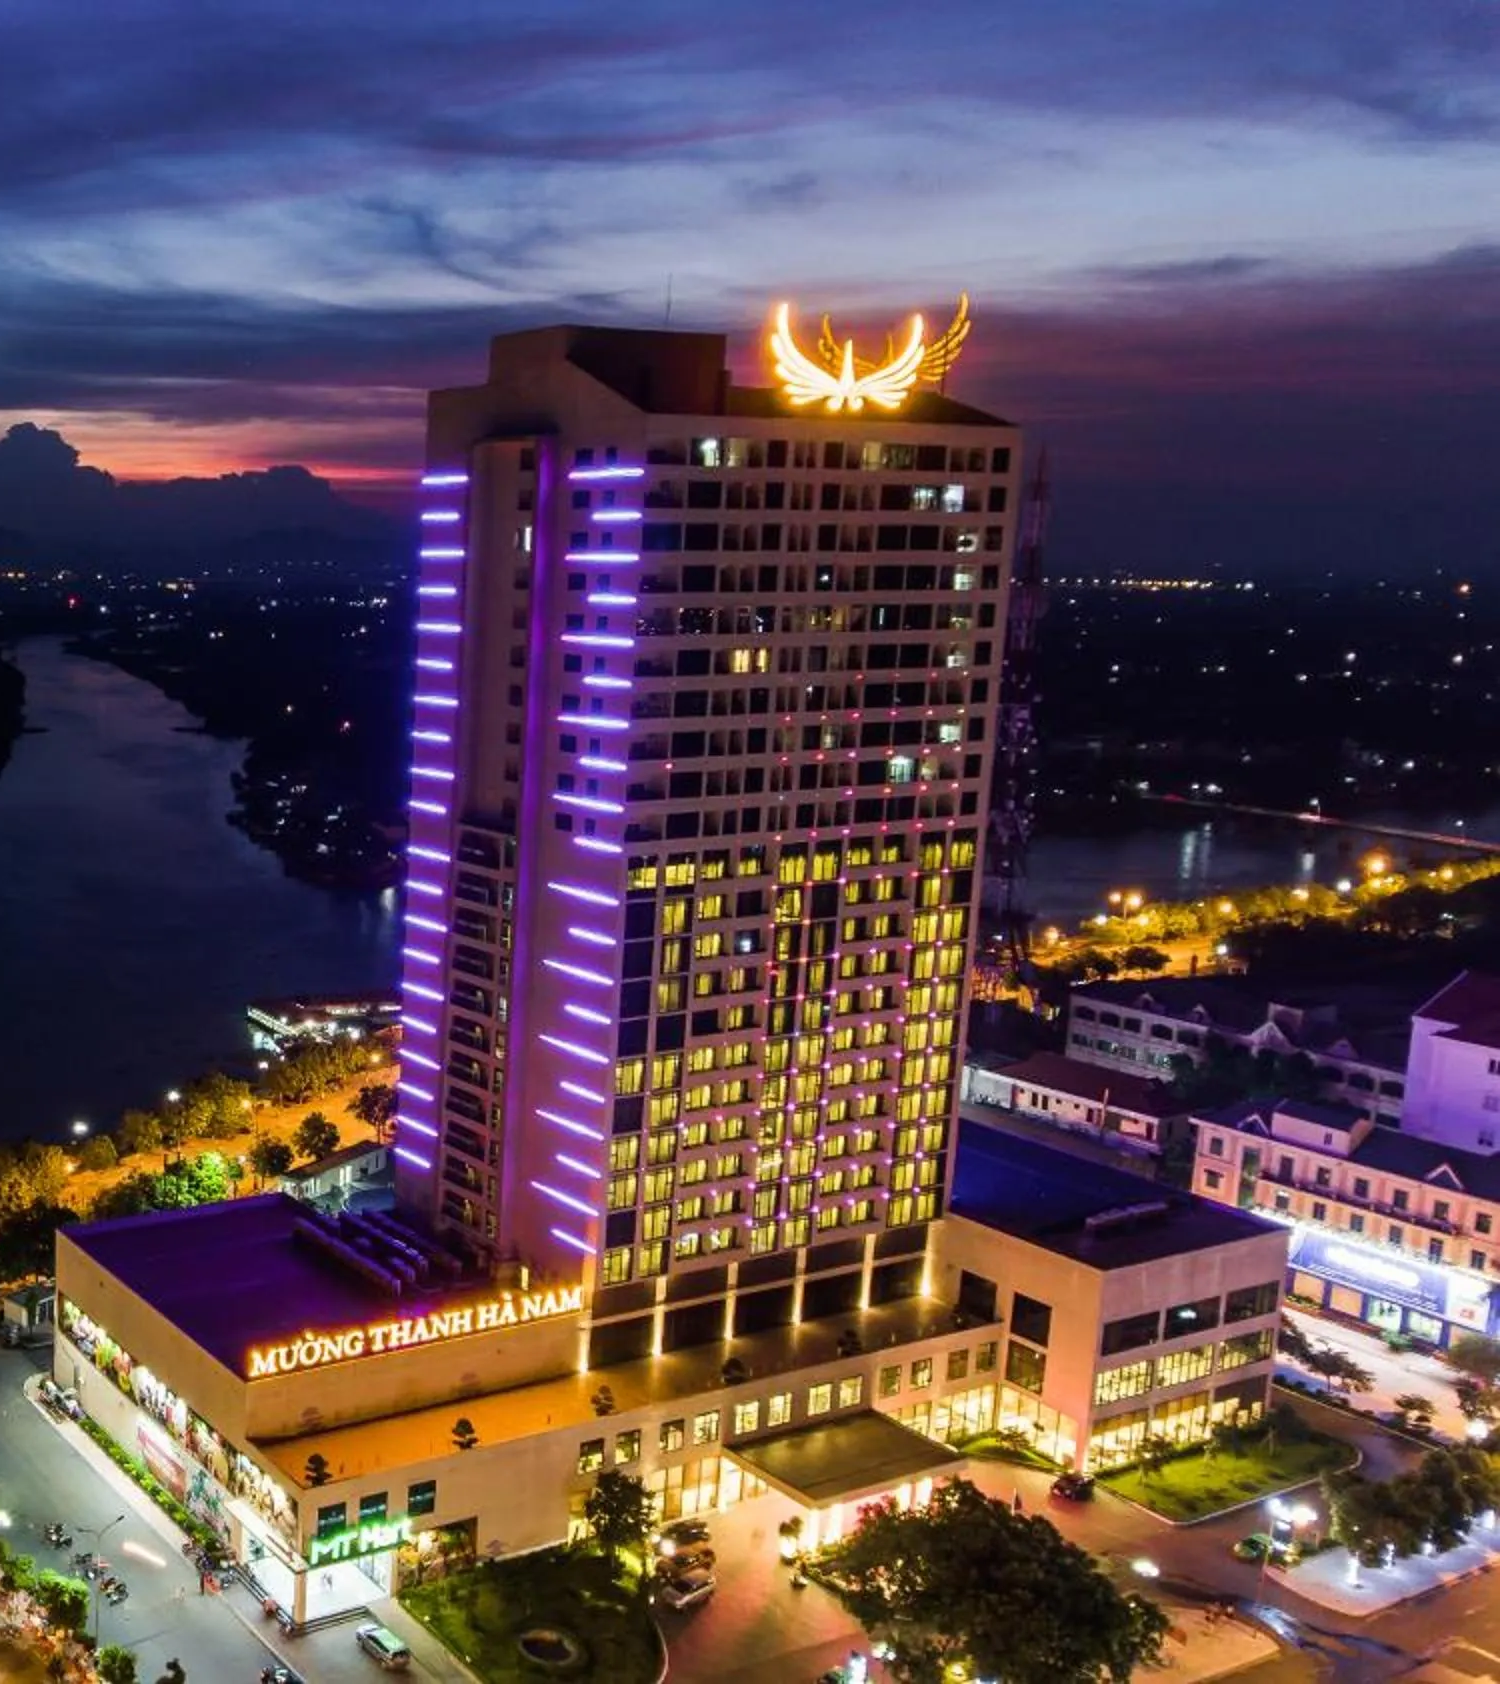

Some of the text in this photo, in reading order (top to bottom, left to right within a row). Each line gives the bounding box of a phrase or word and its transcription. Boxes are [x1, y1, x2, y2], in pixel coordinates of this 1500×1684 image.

[248, 1285, 585, 1378] MƯỜNG THANH HÀ NAM
[309, 1530, 359, 1566] MT
